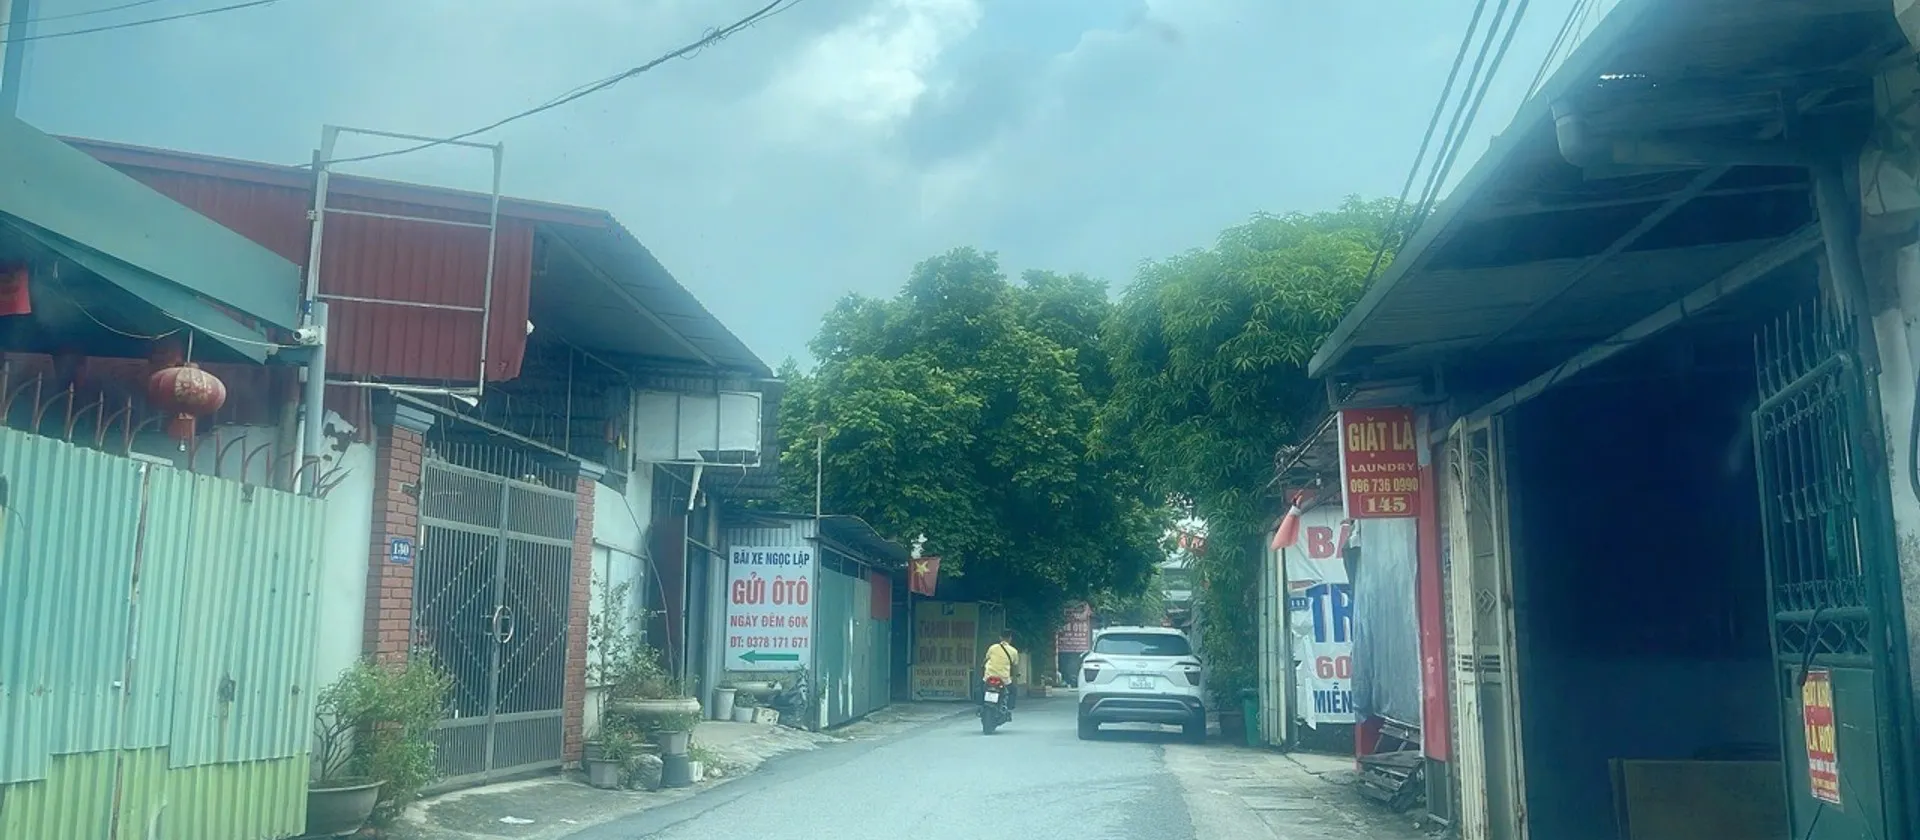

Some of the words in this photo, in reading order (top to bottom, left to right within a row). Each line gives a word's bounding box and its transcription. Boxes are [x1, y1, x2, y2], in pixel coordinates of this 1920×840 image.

[1348, 415, 1388, 458] GIẶT
[1392, 414, 1415, 451] LÀ
[1351, 462, 1414, 473] LAUNDRY
[1350, 478, 1369, 493] 096
[1371, 477, 1391, 492] 736
[1367, 496, 1407, 512] 145
[394, 542, 409, 556] 130
[751, 552, 764, 565] XE
[766, 552, 790, 568] NGỌC
[793, 550, 810, 568] LẬP
[732, 571, 765, 605] GỬI
[772, 574, 808, 605] ÔTÔ
[730, 612, 758, 628] NGÀY
[788, 615, 808, 628] 60K
[747, 636, 770, 648] 0378
[773, 637, 788, 649] 171
[791, 637, 808, 649] 671
[1313, 681, 1354, 713] MIỄN
